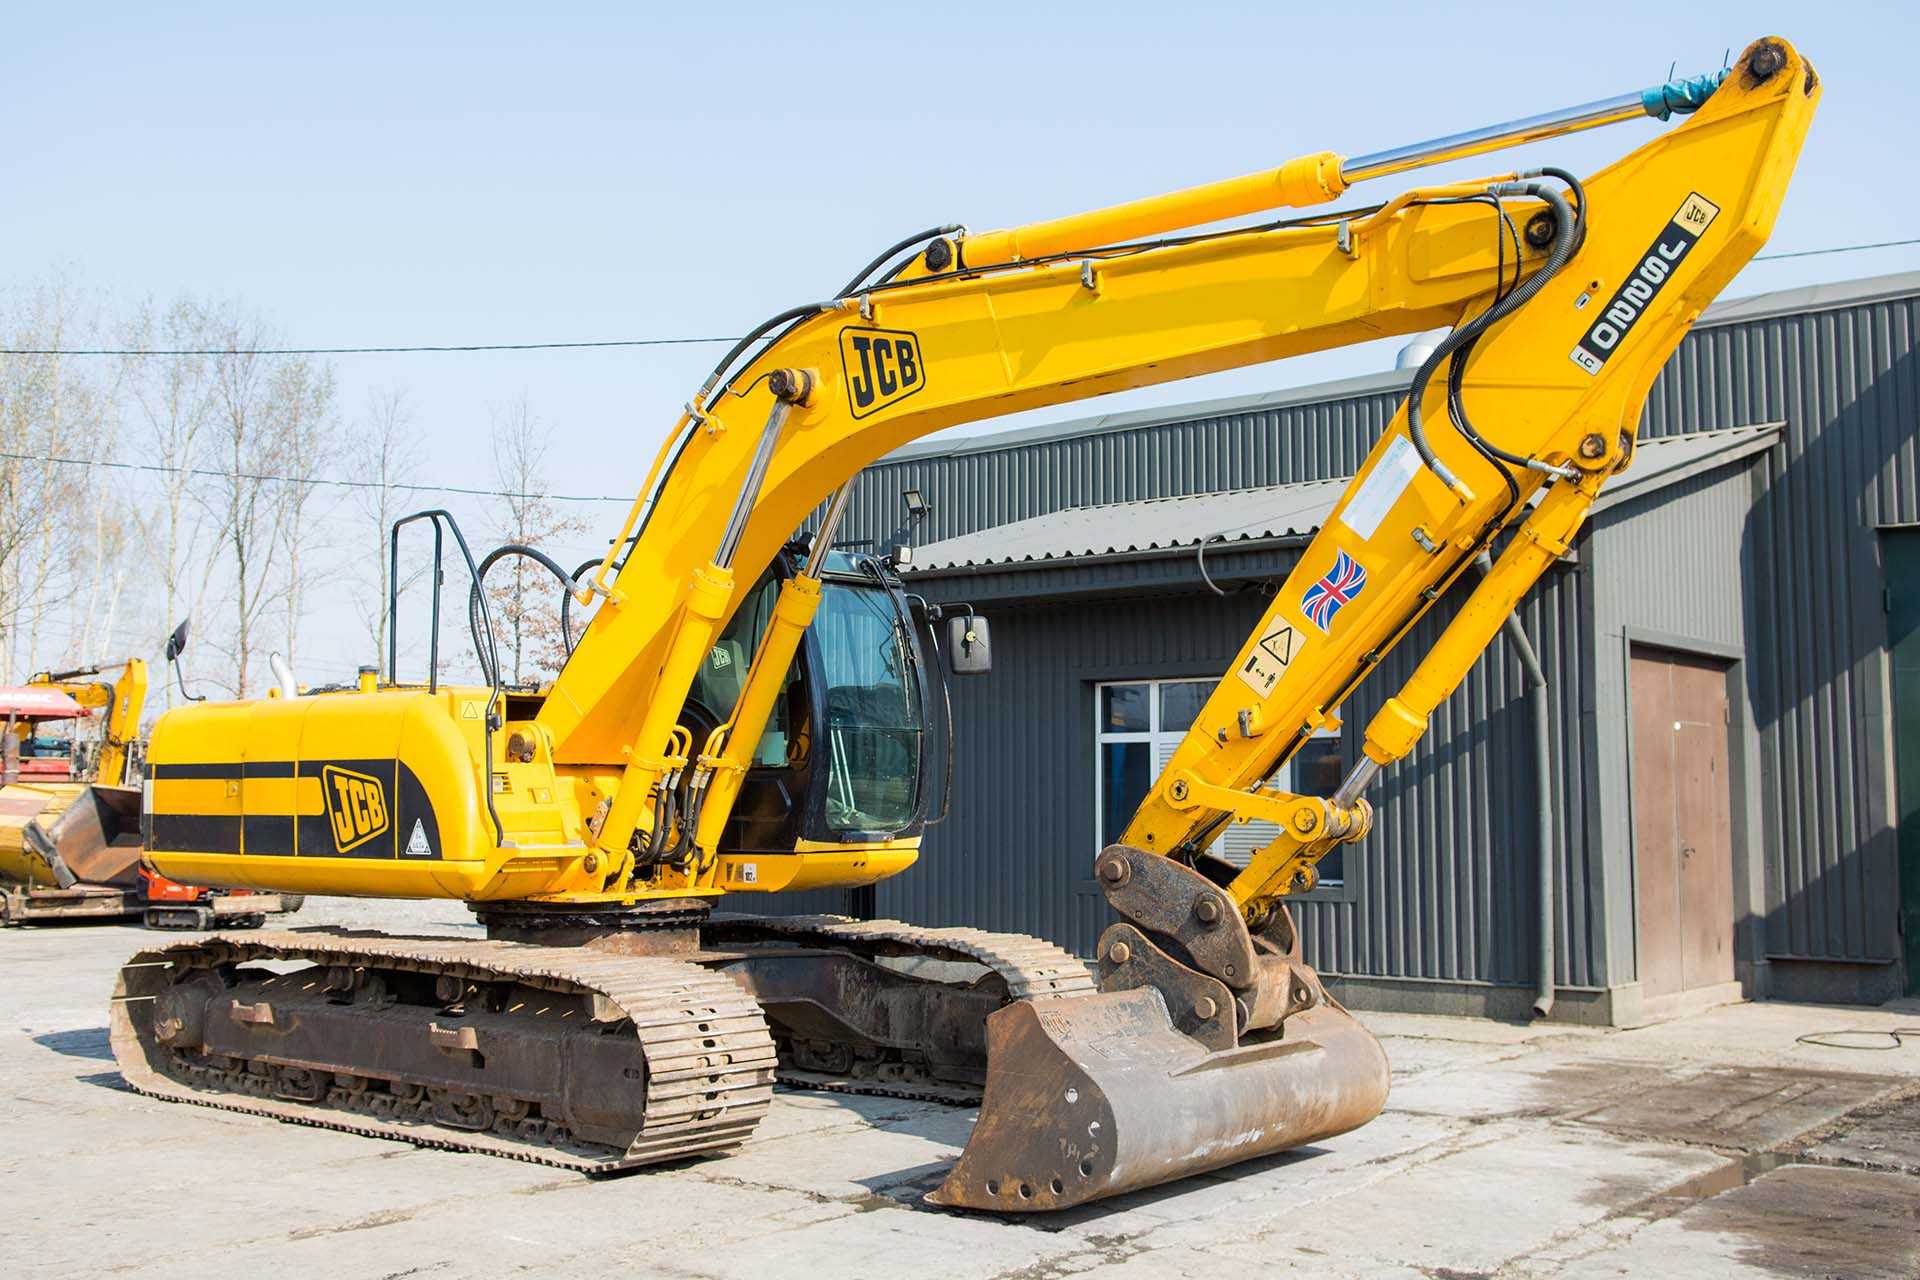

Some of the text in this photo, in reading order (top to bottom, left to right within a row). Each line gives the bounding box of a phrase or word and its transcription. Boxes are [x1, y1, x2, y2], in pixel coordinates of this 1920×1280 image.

[1686, 204, 1706, 224] JCB
[1590, 240, 1687, 350] JS220
[852, 336, 917, 408] JCB
[1577, 352, 1595, 368] LC
[713, 647, 730, 666] JCB
[333, 774, 385, 843] JCB
